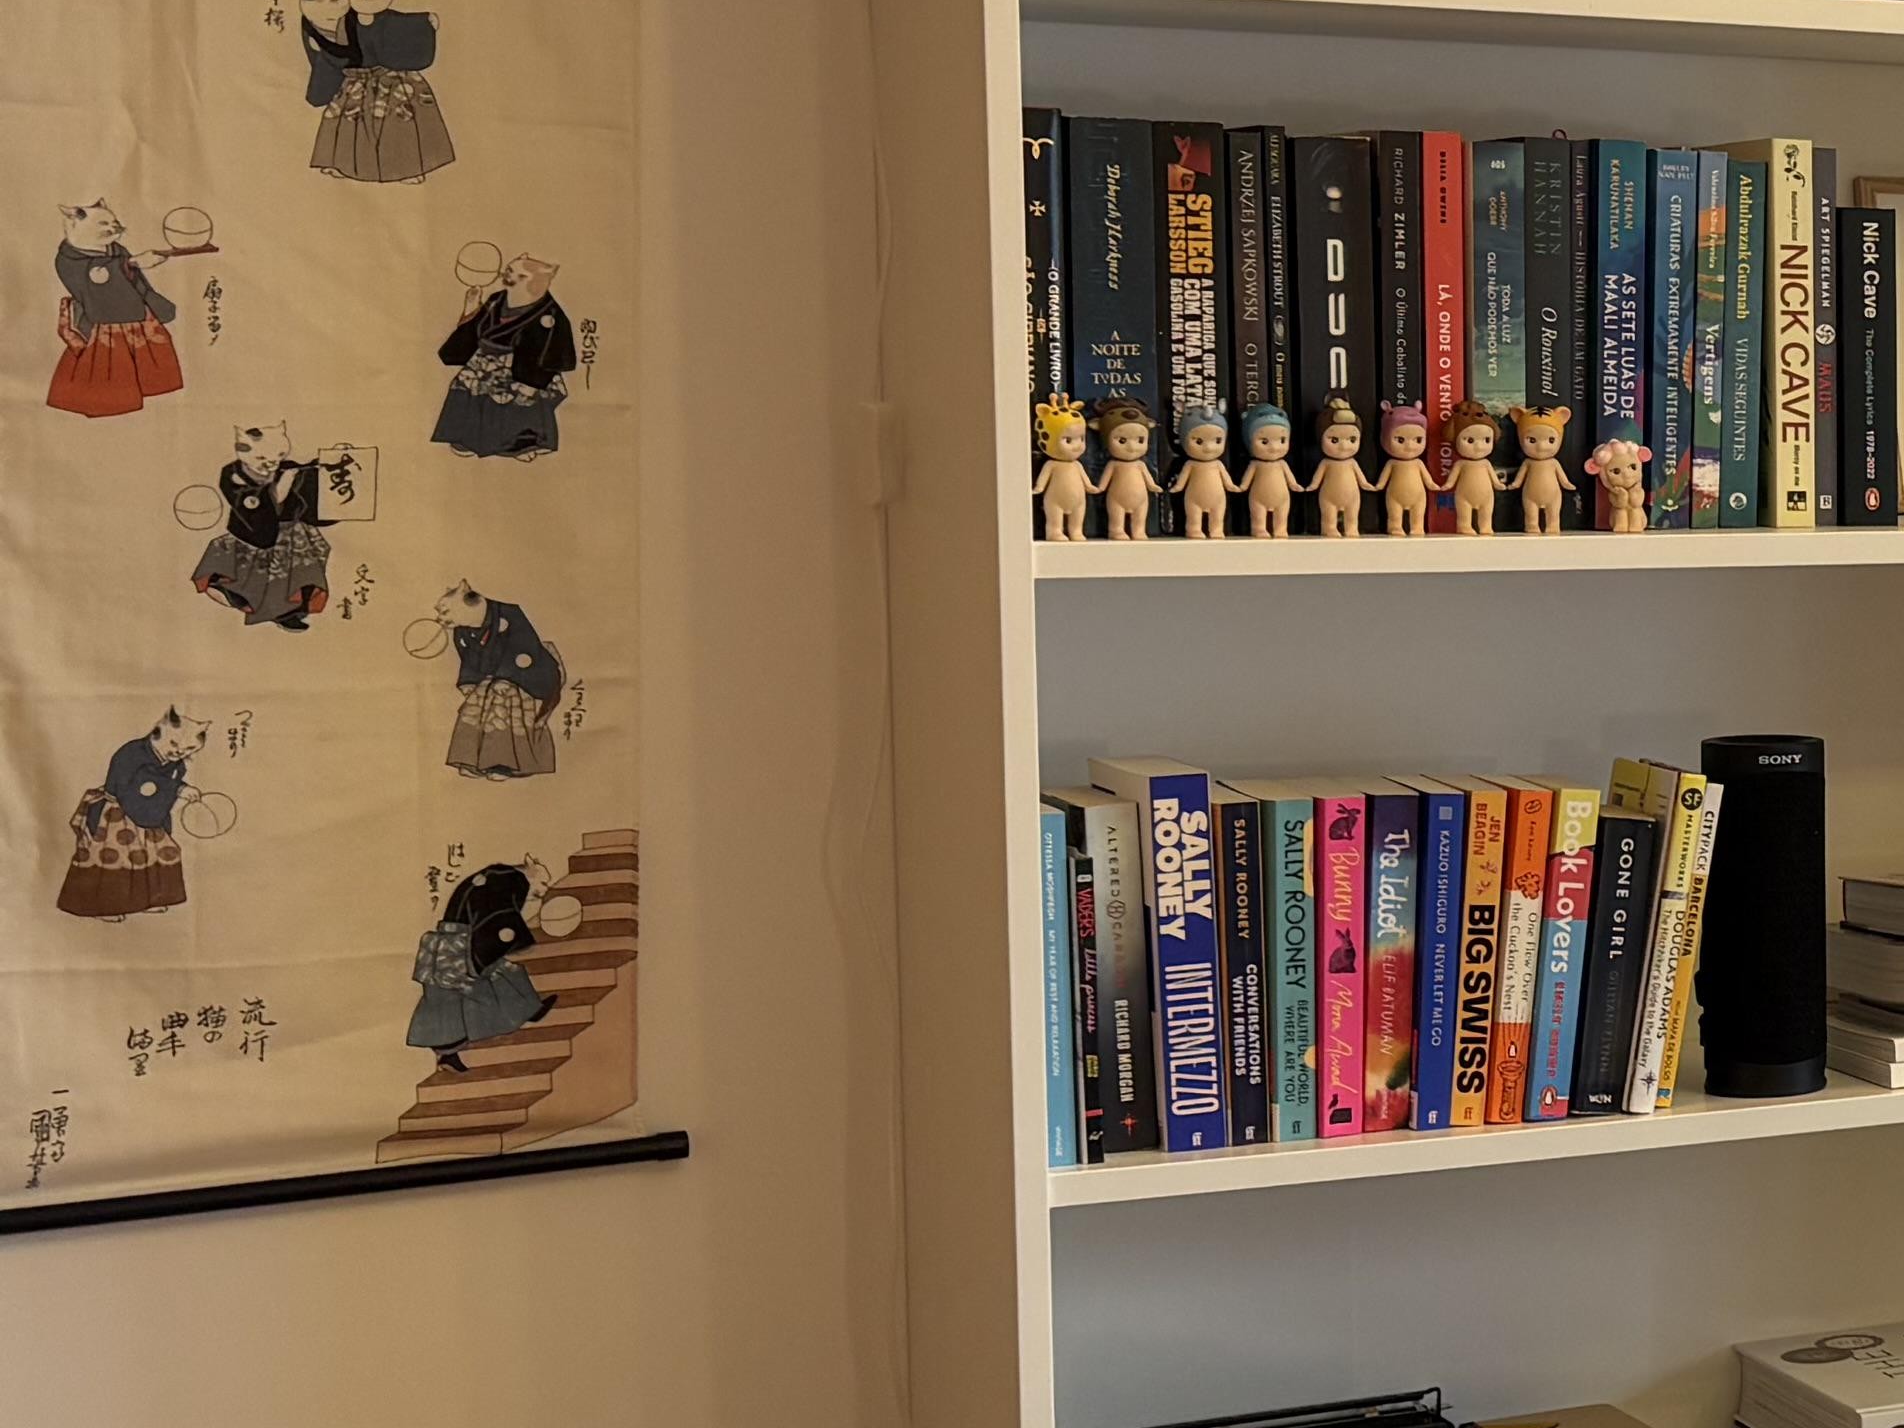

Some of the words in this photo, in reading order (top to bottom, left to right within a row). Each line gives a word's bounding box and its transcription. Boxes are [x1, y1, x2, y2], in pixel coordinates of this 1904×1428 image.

[1240, 150, 1255, 225] ANDRZEJ
[1820, 198, 1831, 223] ART
[1167, 193, 1187, 274] LARSSON
[1187, 193, 1213, 274] STIEG
[1395, 213, 1406, 270] ZIMLER
[1670, 195, 1681, 270] CRIATURAS
[1862, 221, 1879, 265] Nick
[1183, 278, 1199, 314] COM
[1242, 229, 1258, 322] SAPKOWSKI
[1622, 273, 1636, 293] AS
[1780, 244, 1809, 335] NICK
[1821, 228, 1832, 307] SPIEGELMAN
[1862, 271, 1879, 319] Cave
[1541, 307, 1558, 323] O
[1603, 275, 1618, 332] MAALI
[1622, 297, 1636, 330] SETE
[1667, 276, 1681, 380] EXTREMAMENTE
[1092, 343, 1141, 357] NOITE
[1106, 358, 1125, 370] DE
[1184, 317, 1200, 355] UMA
[1542, 327, 1559, 397] Rouxinol
[1621, 336, 1636, 391] LUAS
[1701, 324, 1721, 405] Vertigens
[1091, 372, 1142, 386] TODAS
[1185, 358, 1202, 408] LATA
[1603, 337, 1617, 417] ALMEIDA
[1621, 395, 1635, 419] DE
[1780, 342, 1811, 444] CAVE
[1818, 363, 1833, 413] MAUS
[1665, 386, 1678, 475] INTELIGENTES
[1758, 754, 1802, 766] SONY
[1475, 803, 1488, 856] BEAGIN
[1490, 816, 1502, 843] JEN
[1685, 793, 1701, 805] SF
[1179, 810, 1214, 920] SALLY
[1233, 819, 1247, 866] SALLY
[1284, 819, 1303, 886] SALLY
[1385, 828, 1410, 869] The
[1559, 799, 1593, 878] Book
[1616, 837, 1634, 899] GONE
[1677, 814, 1693, 888] MASTERWORKS
[1696, 811, 1715, 871] CITYPACK
[1154, 798, 1187, 941] ROONEY
[1328, 845, 1360, 923] Bunny
[1234, 873, 1250, 940] ROONEY
[1376, 874, 1410, 939] Idiot
[1465, 904, 1496, 965] BIG
[1550, 880, 1585, 974] Lovers
[1610, 909, 1627, 960] GIRL
[1681, 876, 1704, 957] BARCELONA
[1284, 891, 1307, 990] ROONEY
[1232, 976, 1244, 1009] WITH
[1114, 999, 1131, 1052] RICHARD
[1164, 962, 1220, 1117] INTERMEZZO
[1233, 1013, 1245, 1076] FRIENDS
[1246, 964, 1262, 1085] CONVERSATIONS
[1456, 970, 1493, 1095] SWISS
[1117, 1056, 1135, 1103] MORGAN
